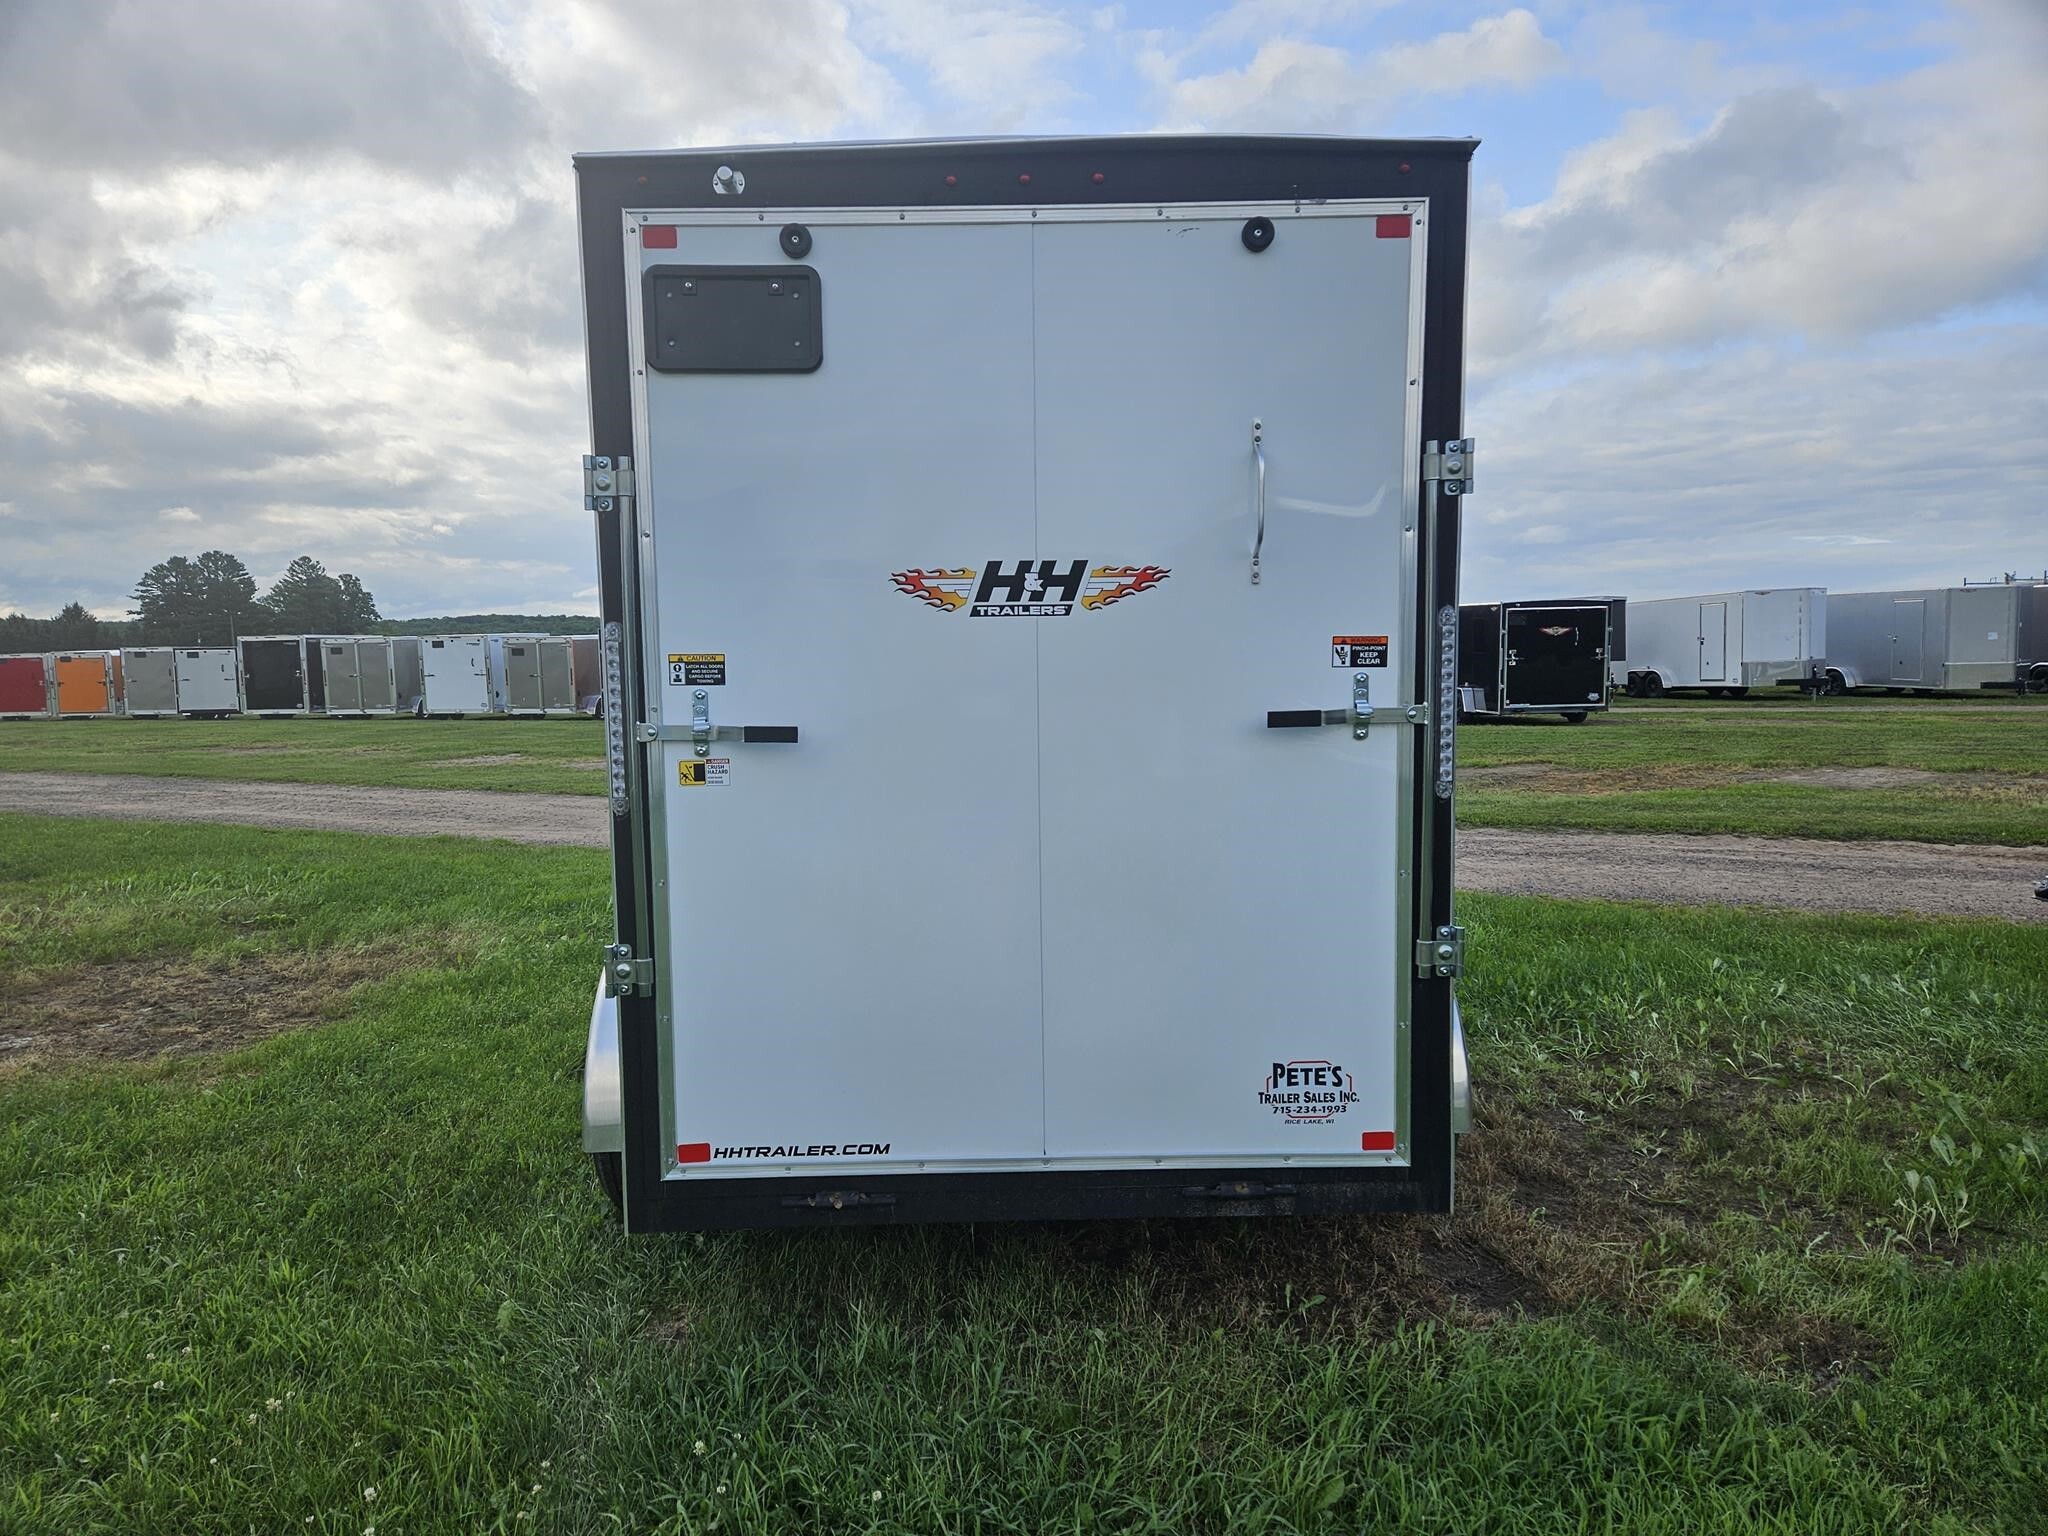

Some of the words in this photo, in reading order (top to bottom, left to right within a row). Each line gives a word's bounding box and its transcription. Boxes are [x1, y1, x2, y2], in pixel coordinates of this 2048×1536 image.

[974, 560, 1088, 602] H&H
[977, 605, 1066, 615] TRAILERS
[1272, 1062, 1343, 1089] PETE'S
[1258, 1092, 1300, 1104] TRAILER
[1303, 1091, 1336, 1104] SALES
[1339, 1090, 1360, 1103] INC.
[1272, 1105, 1347, 1114] 715-234-1993
[713, 1144, 891, 1159] HHTRAILER.COM
